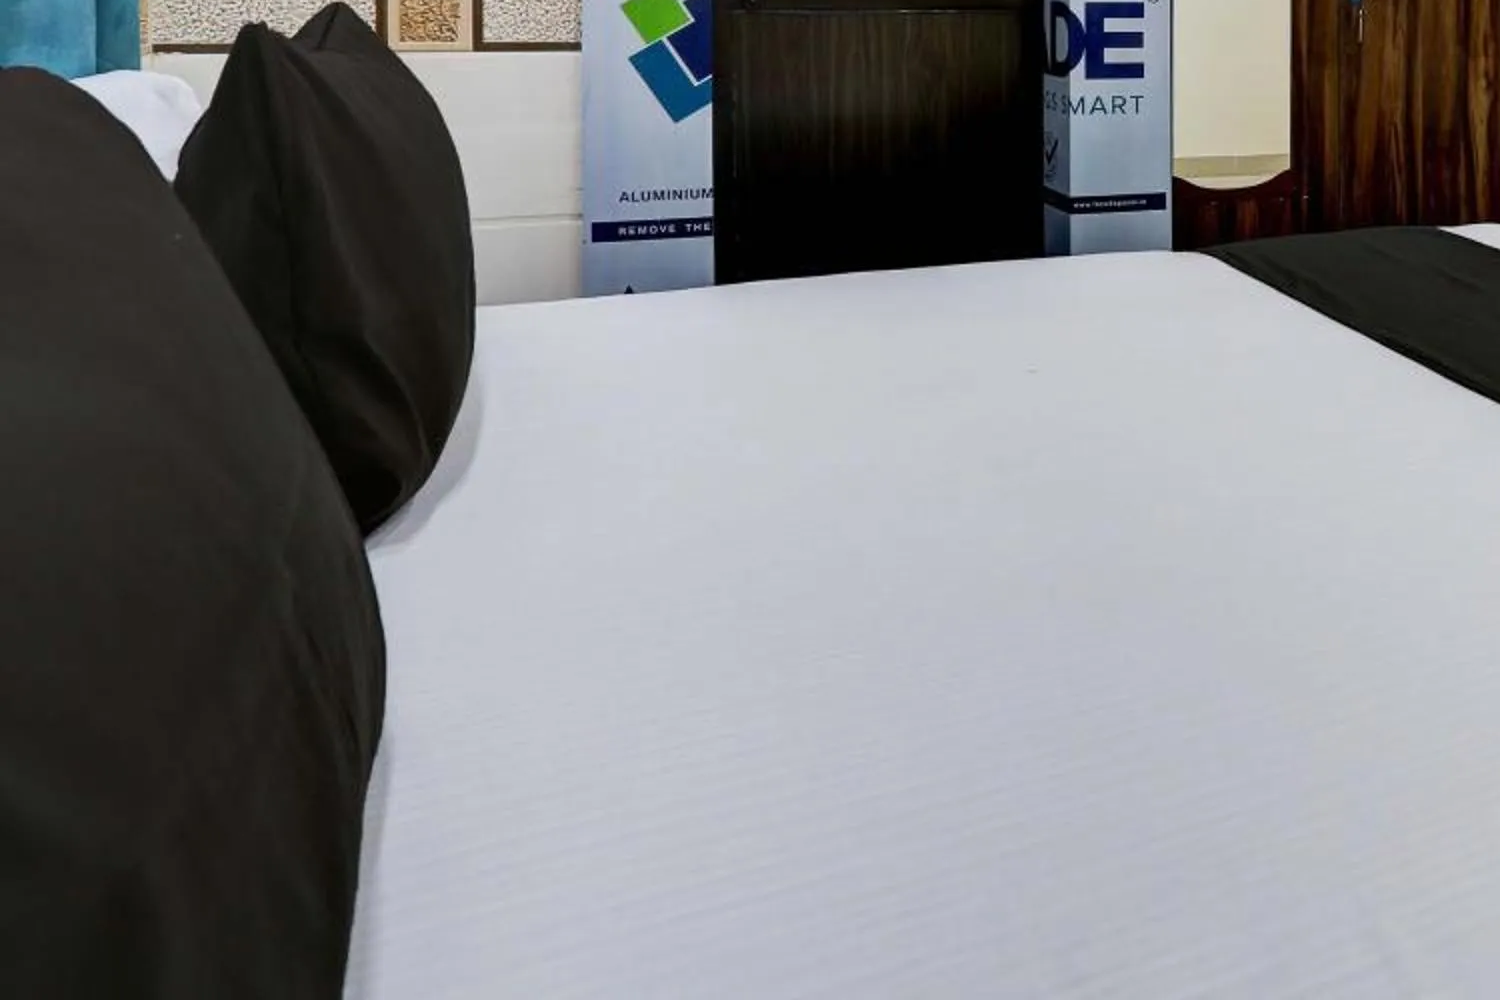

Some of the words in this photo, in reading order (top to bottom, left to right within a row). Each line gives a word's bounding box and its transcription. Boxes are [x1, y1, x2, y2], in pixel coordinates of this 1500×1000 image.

[1045, 0, 1145, 80] DE
[619, 187, 715, 203] ALUMINIUM
[618, 223, 677, 237] REMOVE
[685, 221, 713, 233] THE
